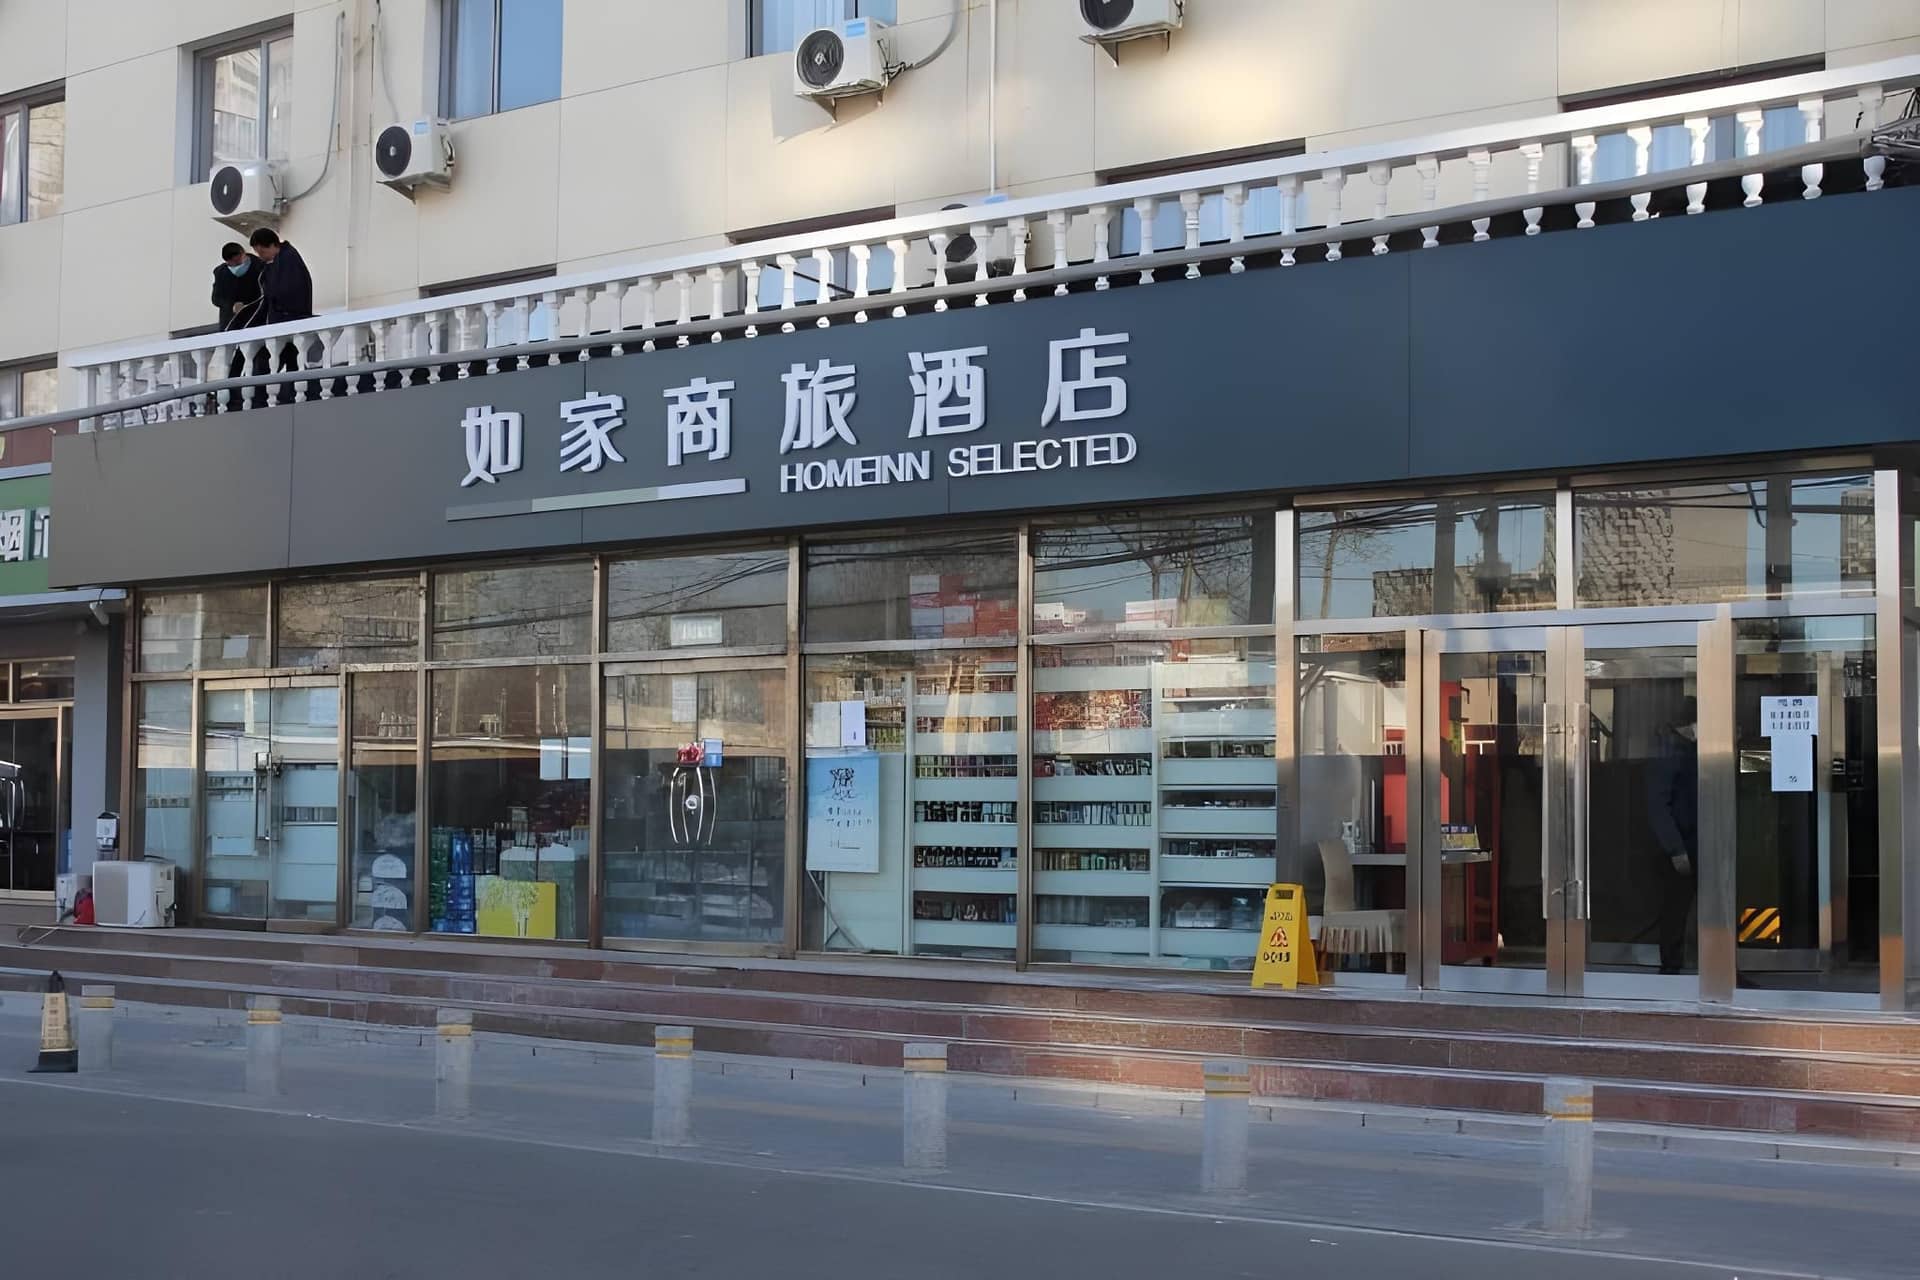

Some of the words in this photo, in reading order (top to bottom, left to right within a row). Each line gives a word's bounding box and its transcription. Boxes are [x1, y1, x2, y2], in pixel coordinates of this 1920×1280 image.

[460, 327, 1130, 487] 如家商旅酒店
[780, 450, 931, 492] HOMEINN
[947, 432, 1138, 478] SELECTED
